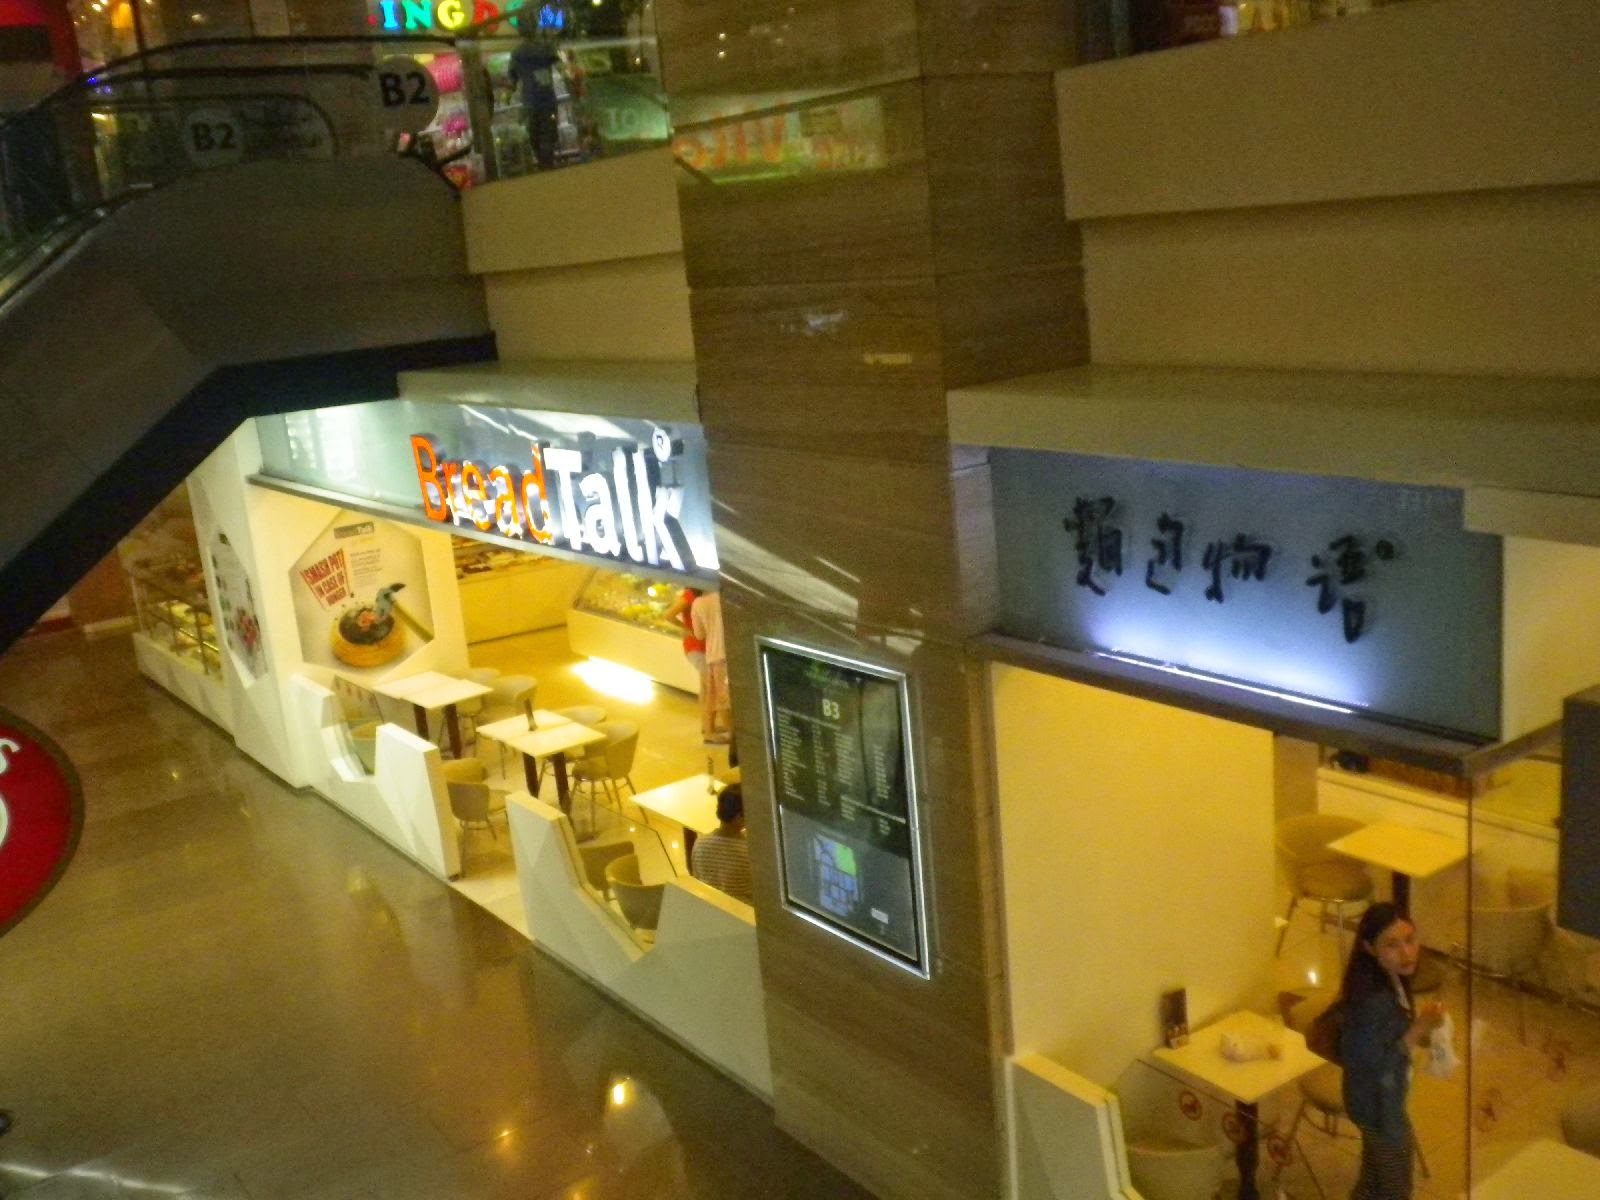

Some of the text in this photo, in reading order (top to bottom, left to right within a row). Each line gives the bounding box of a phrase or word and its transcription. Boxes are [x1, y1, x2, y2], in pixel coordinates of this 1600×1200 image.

[379, 72, 430, 107] B2
[189, 122, 237, 151] B2
[822, 698, 841, 720] B3
